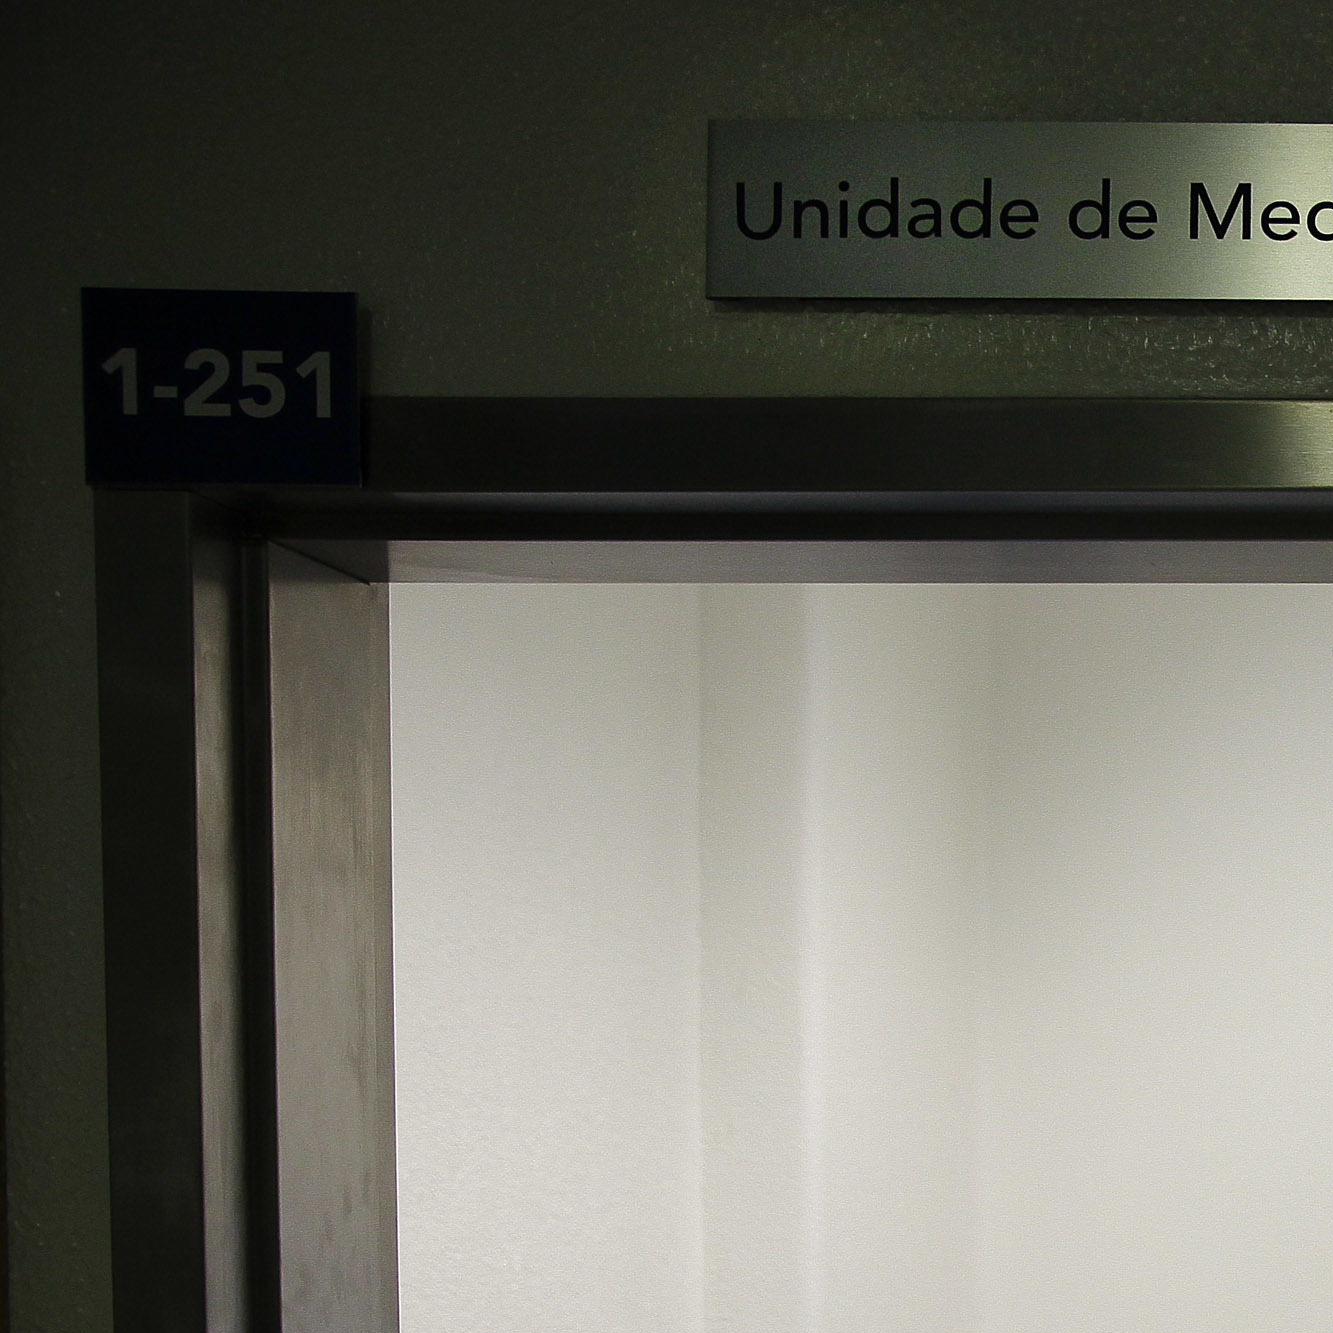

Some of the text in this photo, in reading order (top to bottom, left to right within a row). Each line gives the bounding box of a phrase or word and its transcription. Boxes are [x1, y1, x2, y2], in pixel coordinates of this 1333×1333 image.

[734, 178, 1039, 241] Unidade
[1068, 179, 1158, 241] de
[101, 347, 331, 418] 1-251
